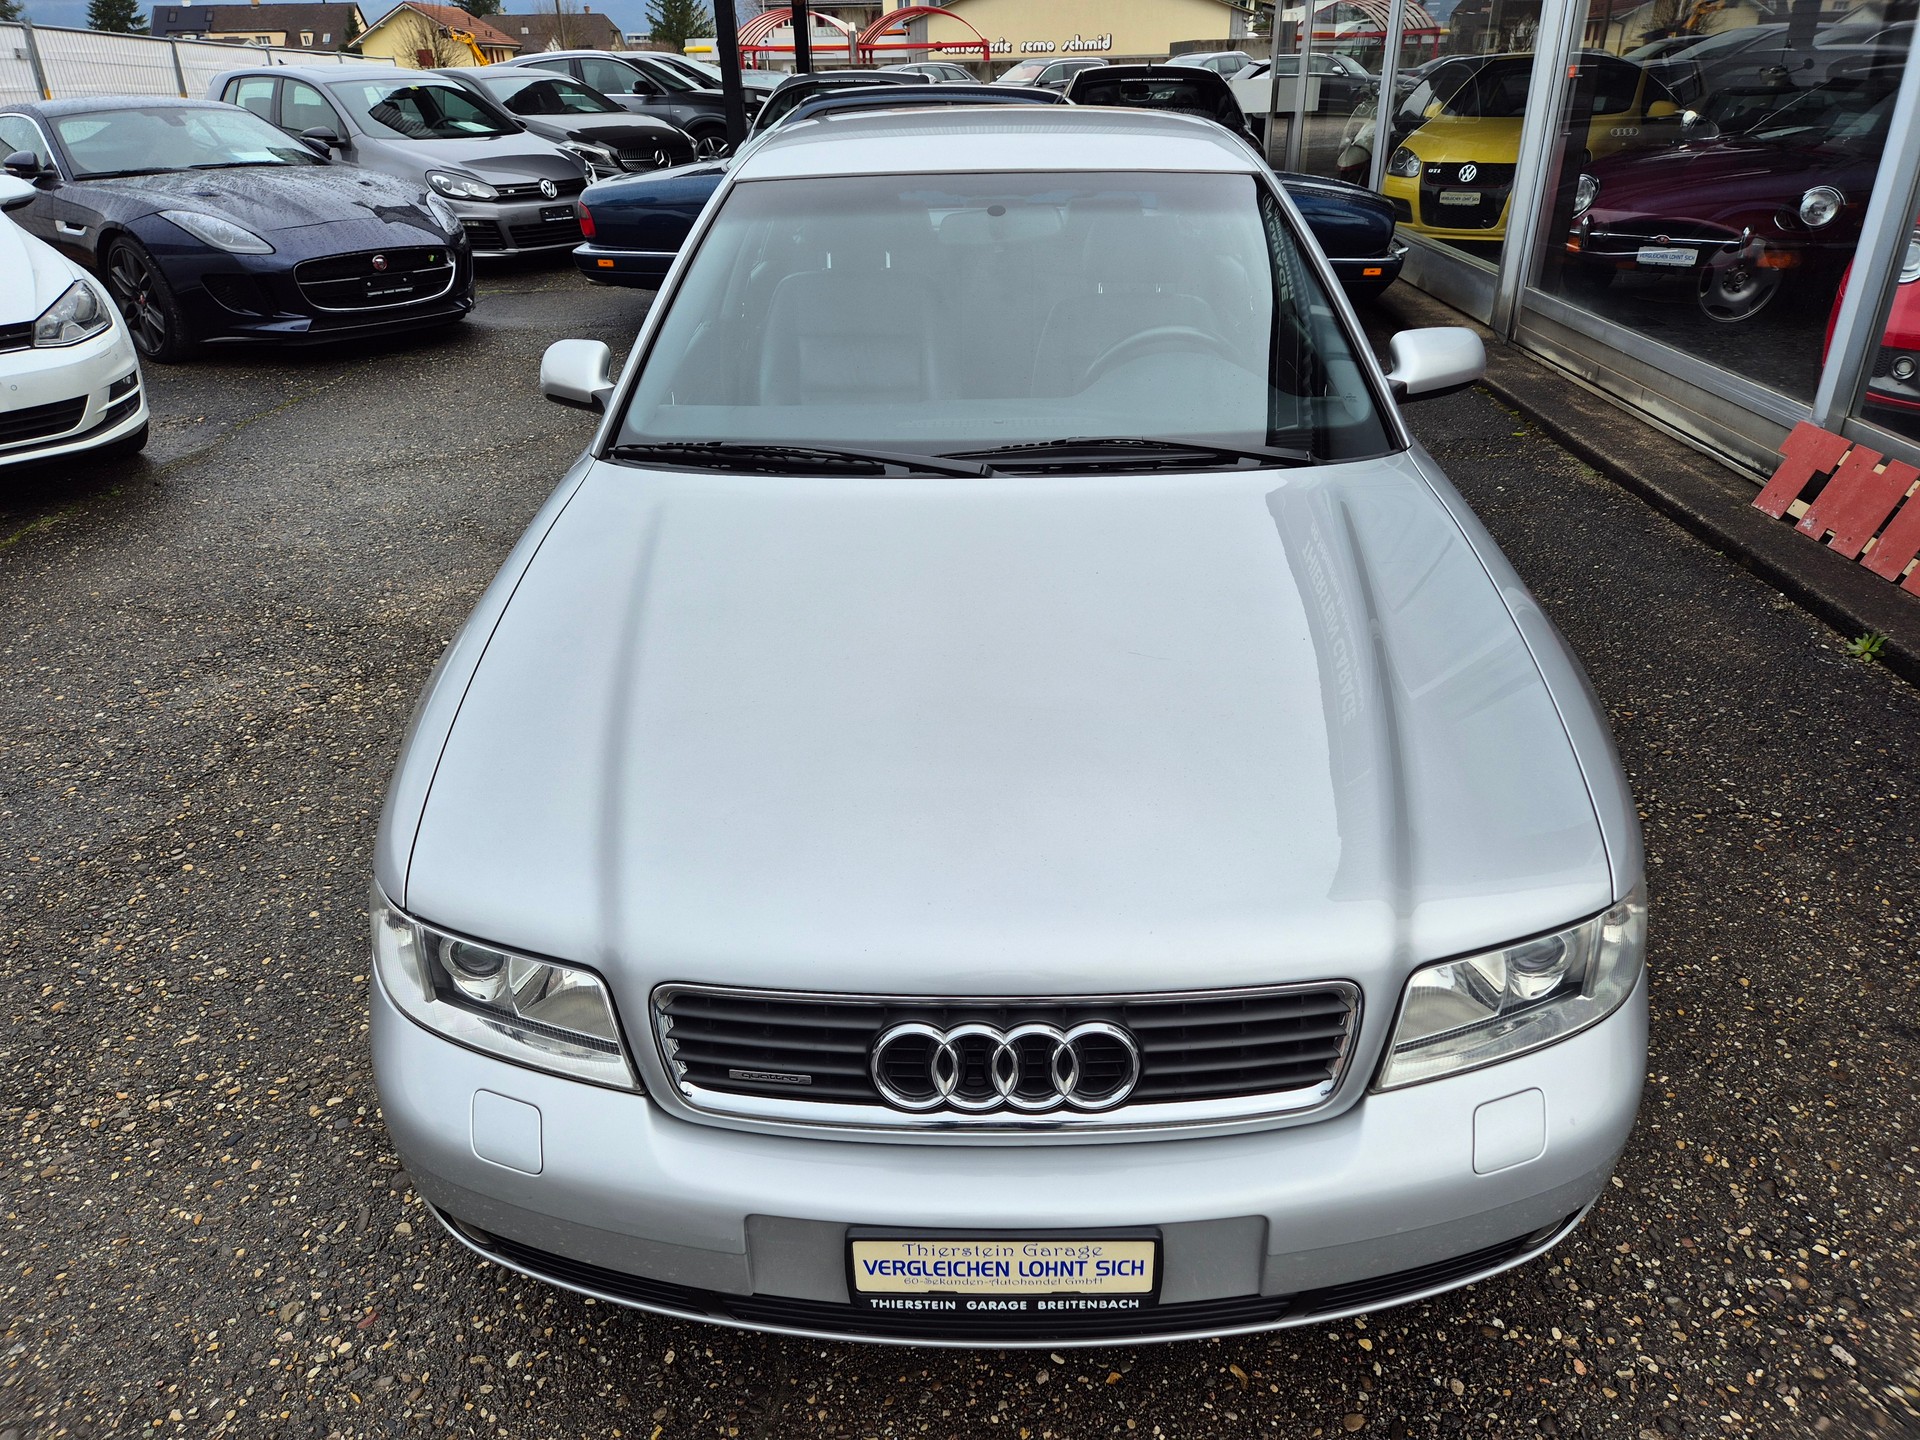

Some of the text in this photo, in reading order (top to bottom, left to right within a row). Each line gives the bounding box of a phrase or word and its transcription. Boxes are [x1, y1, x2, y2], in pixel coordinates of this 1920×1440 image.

[1020, 40, 1056, 53] remo
[1061, 33, 1112, 52] schmid
[741, 1072, 799, 1082] quattro
[902, 1243, 1104, 1259] Thierstein Garage
[863, 1259, 1145, 1277] VERGLEICHEN LOHNT SICH
[1065, 1277, 1103, 1286] GmbH
[870, 1299, 1140, 1311] THIERSTEIN GARAGE BREITENBACH
